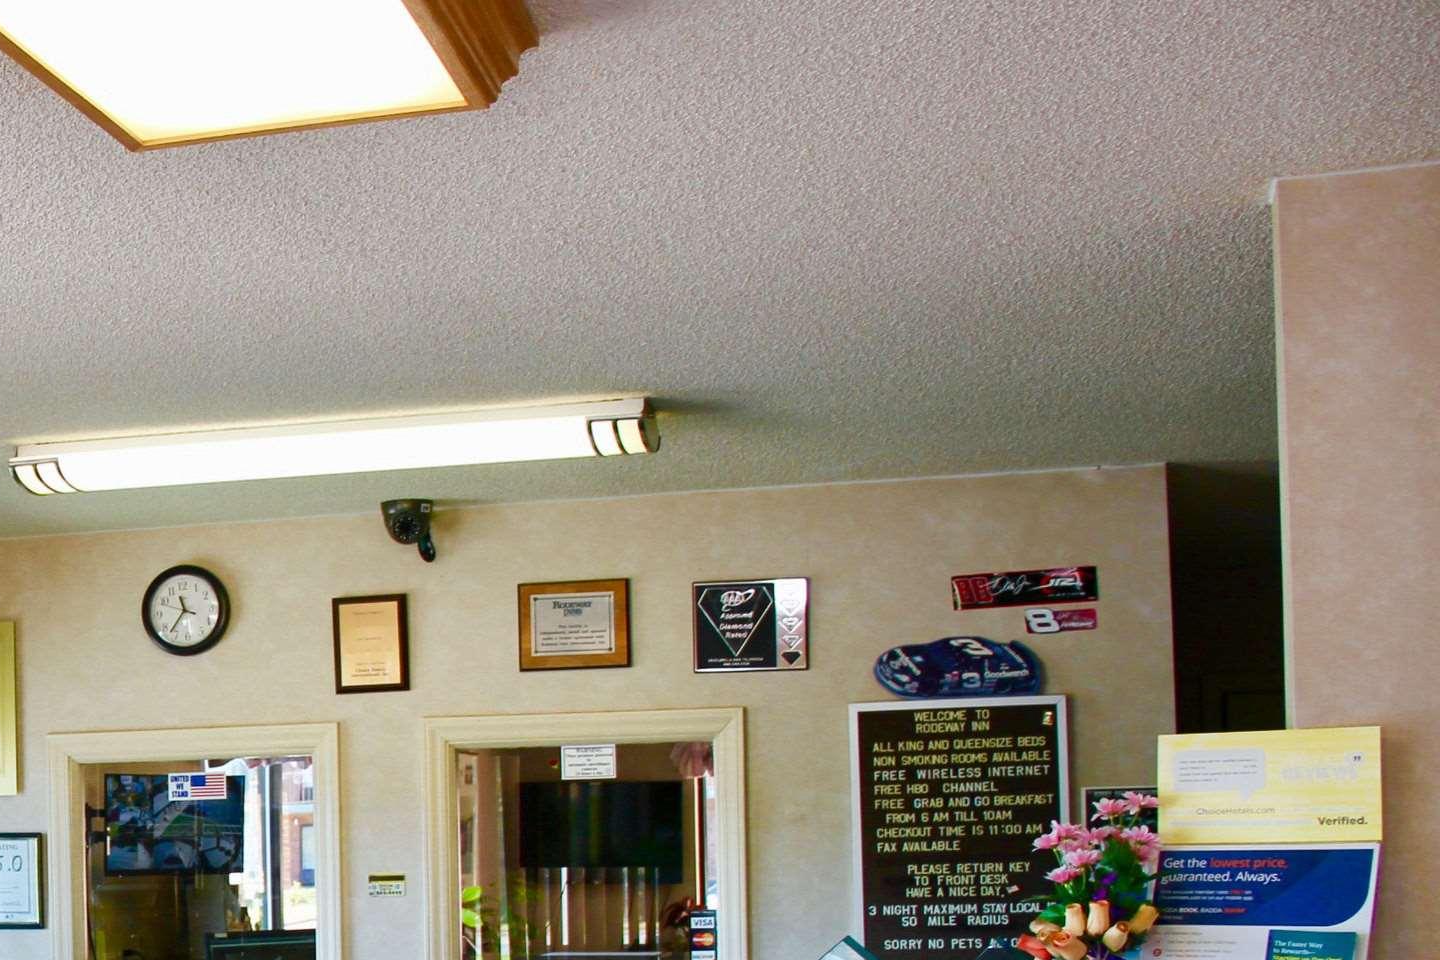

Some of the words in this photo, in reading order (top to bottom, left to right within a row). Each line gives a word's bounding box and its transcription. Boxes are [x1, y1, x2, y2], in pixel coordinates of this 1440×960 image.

[1025, 607, 1060, 634] 8
[961, 672, 981, 688] 3
[914, 710, 967, 722] WELCOME
[976, 709, 990, 719] TO
[915, 721, 966, 734] RODEWAY
[971, 721, 990, 731] INN
[873, 742, 895, 752] ALL
[898, 740, 924, 751] KING
[928, 740, 950, 750] AND
[953, 737, 1013, 749] QUEENSIZE
[1017, 736, 1046, 747] BEDS
[873, 756, 896, 767] NON
[901, 754, 949, 766] SMOKING
[951, 752, 988, 764] ROOMS
[992, 750, 1052, 762] AVAILABLE
[874, 770, 907, 781] FREE
[916, 767, 981, 780] WIRELESS
[988, 765, 1050, 777] INTERNET
[874, 784, 901, 795] FREE
[906, 783, 929, 794] HBO
[942, 781, 999, 793] CHANNEL
[874, 798, 905, 810] FREE
[913, 797, 944, 809] GRAB
[948, 796, 970, 807] AND
[974, 796, 990, 807] GO
[993, 794, 1054, 806] BREAKFAST
[886, 812, 915, 824] FROM
[921, 812, 929, 823] 6
[932, 811, 949, 822] AM
[954, 811, 978, 821] TILL
[983, 810, 1012, 820] 10AM
[1317, 816, 1368, 826] Verified.
[876, 827, 933, 839] CHECKOUT
[938, 825, 966, 837] TIME
[972, 825, 984, 835] IS
[1025, 823, 1043, 834] AM
[877, 842, 897, 853] FAX
[902, 840, 961, 852] AVAILABLE
[907, 864, 950, 875] PLEASE
[956, 863, 1003, 874] RETURN
[1009, 862, 1030, 872] KEY
[1163, 858, 1185, 868] Get
[1187, 858, 1207, 868] the
[1210, 858, 1250, 868] lowest
[914, 876, 929, 886] TO
[937, 875, 975, 886] FRONT
[980, 874, 1008, 885] DESK
[1160, 871, 1233, 885] guaranteed.
[1235, 871, 1281, 885] Always.
[905, 887, 932, 898] HAVE
[937, 888, 945, 897] A
[949, 886, 976, 897] NICE
[868, 905, 877, 916] 3
[883, 905, 918, 915] NIGHT
[923, 903, 977, 915] MAXIMUM
[983, 903, 1007, 913] STAY
[1010, 902, 1044, 913] LOCAL
[693, 919, 713, 927] VISA
[927, 916, 957, 926] MILE
[967, 914, 1009, 925] RADIUS
[884, 939, 922, 950] SORRY
[928, 938, 945, 949] NO
[951, 938, 982, 949] PETS
